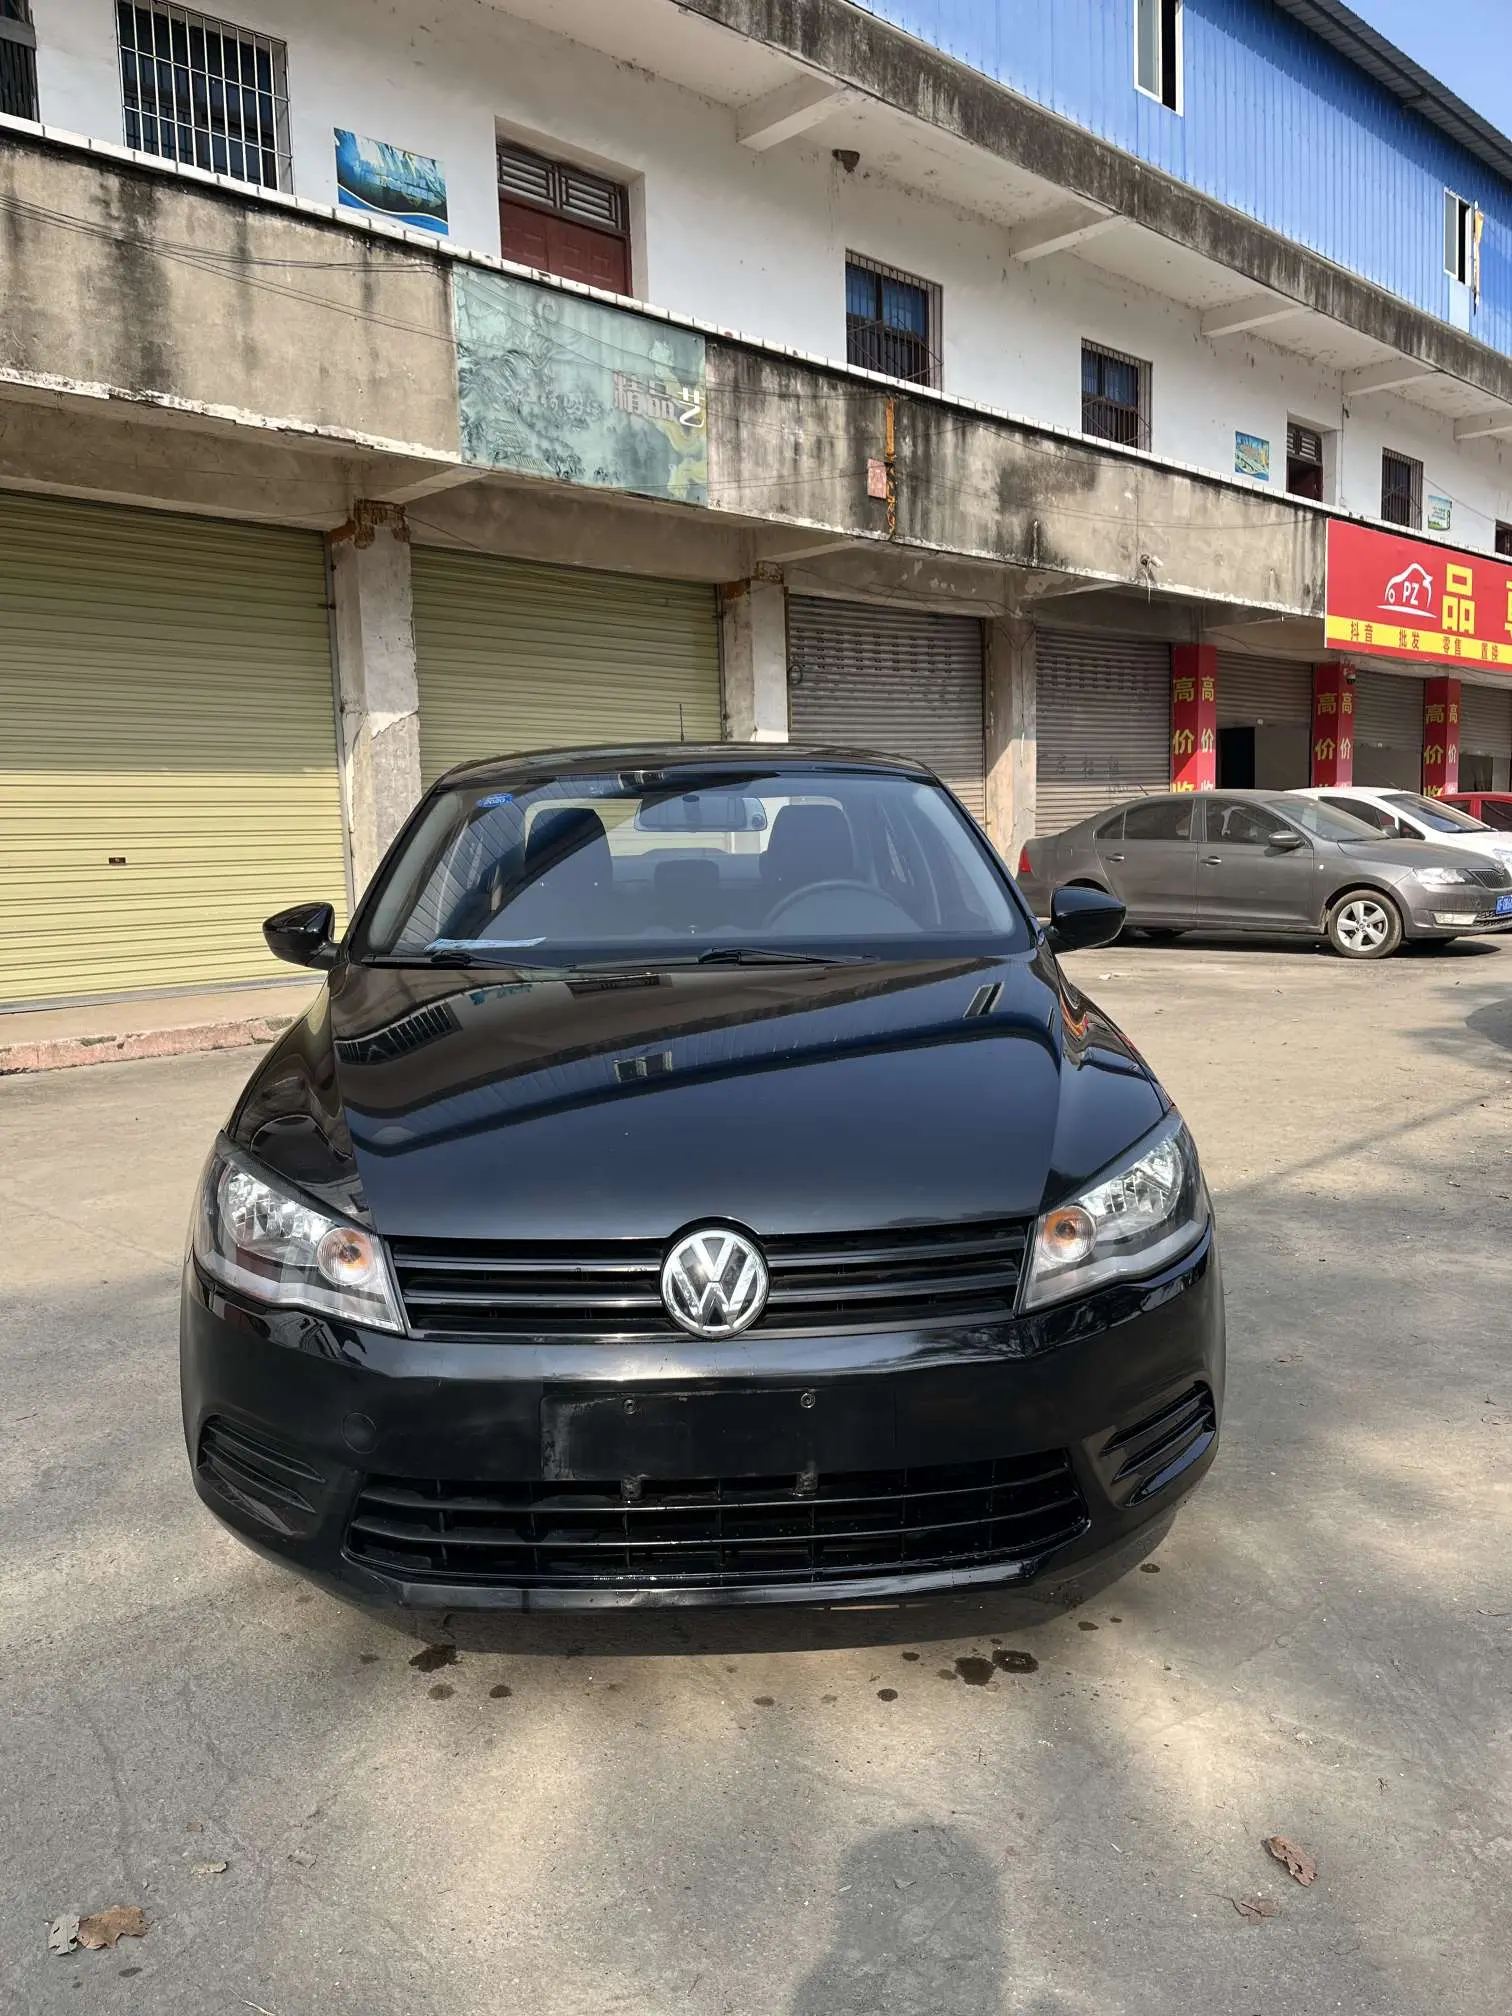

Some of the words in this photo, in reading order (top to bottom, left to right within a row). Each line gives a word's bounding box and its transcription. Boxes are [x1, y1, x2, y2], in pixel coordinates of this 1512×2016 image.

[1402, 581, 1420, 606] PZ
[1350, 621, 1374, 643] 抖音
[1399, 628, 1420, 650] 批发
[1442, 636, 1462, 656] 零售
